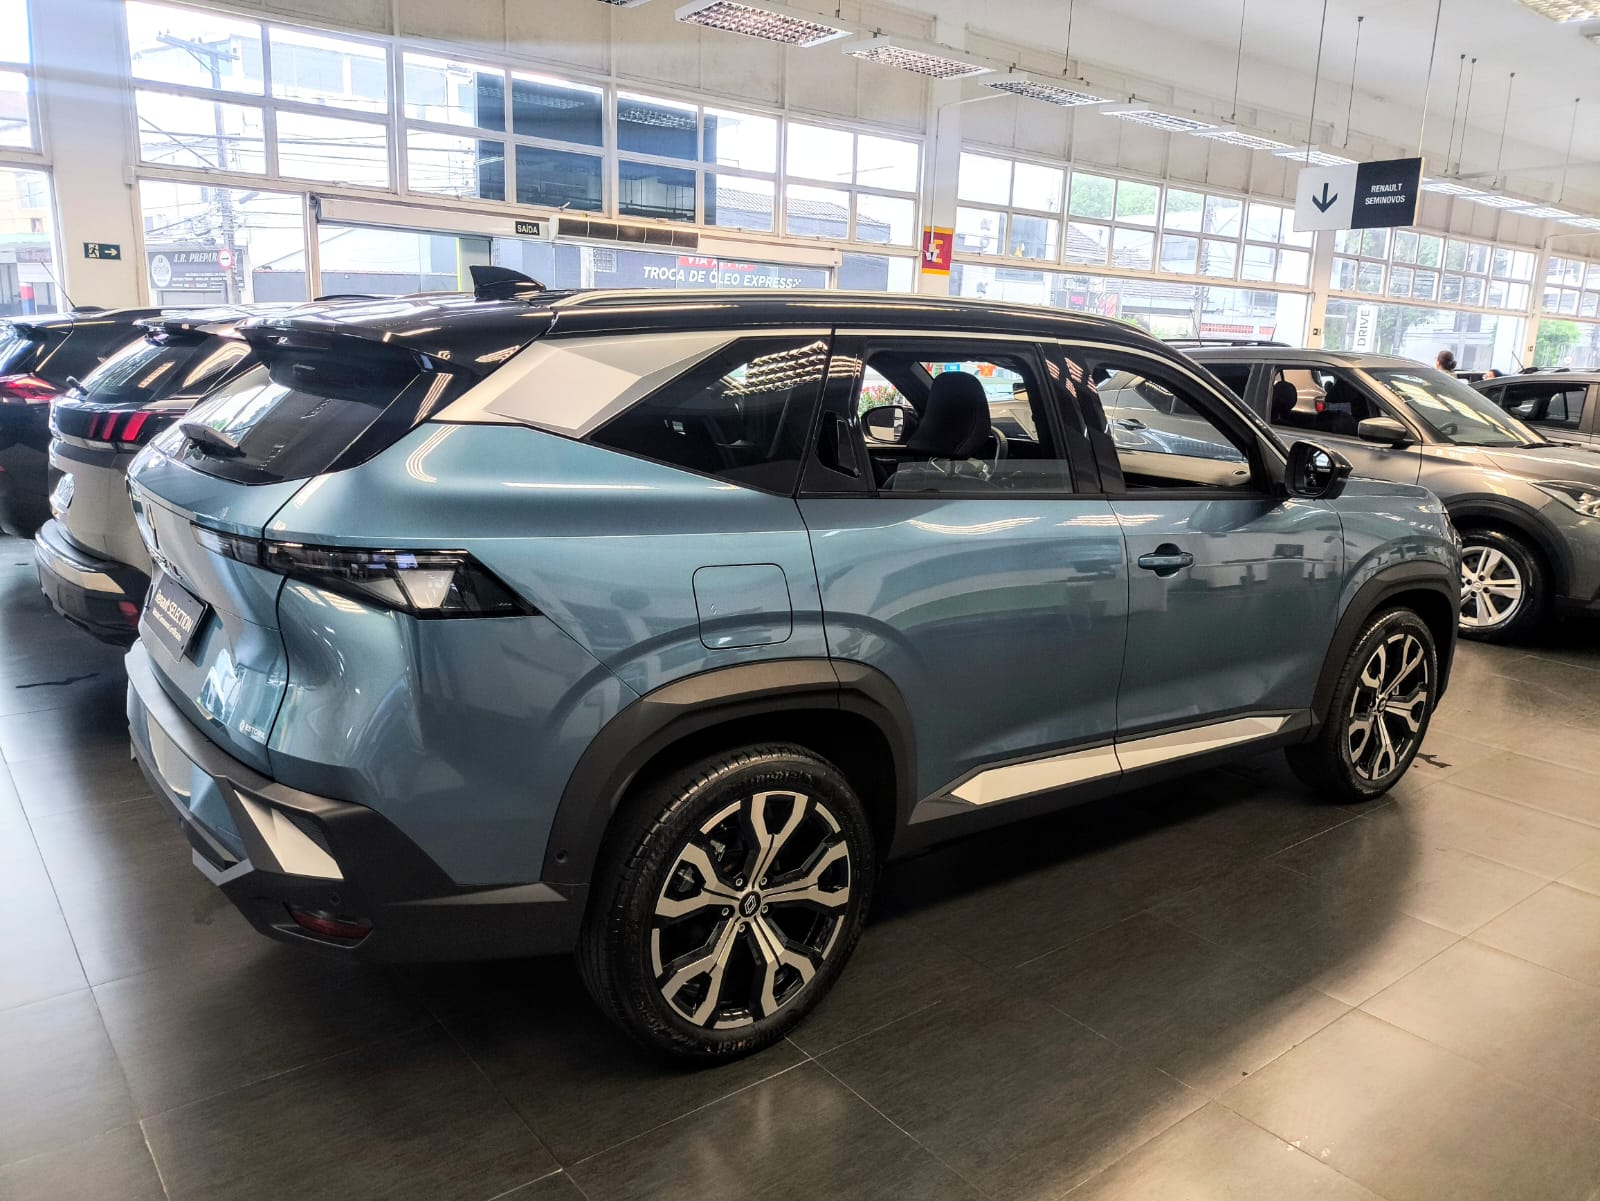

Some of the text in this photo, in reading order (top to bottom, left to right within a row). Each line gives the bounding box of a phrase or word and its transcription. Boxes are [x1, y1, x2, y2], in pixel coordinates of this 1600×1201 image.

[1371, 183, 1403, 193] RENAULT
[1365, 195, 1406, 205] SEMINOVOS
[517, 223, 538, 234] SAÍDA
[643, 266, 793, 289] TROCA DE ÓLEO EXPRESS
[1357, 309, 1370, 347] DRIVE
[167, 601, 193, 633] SELECTION
